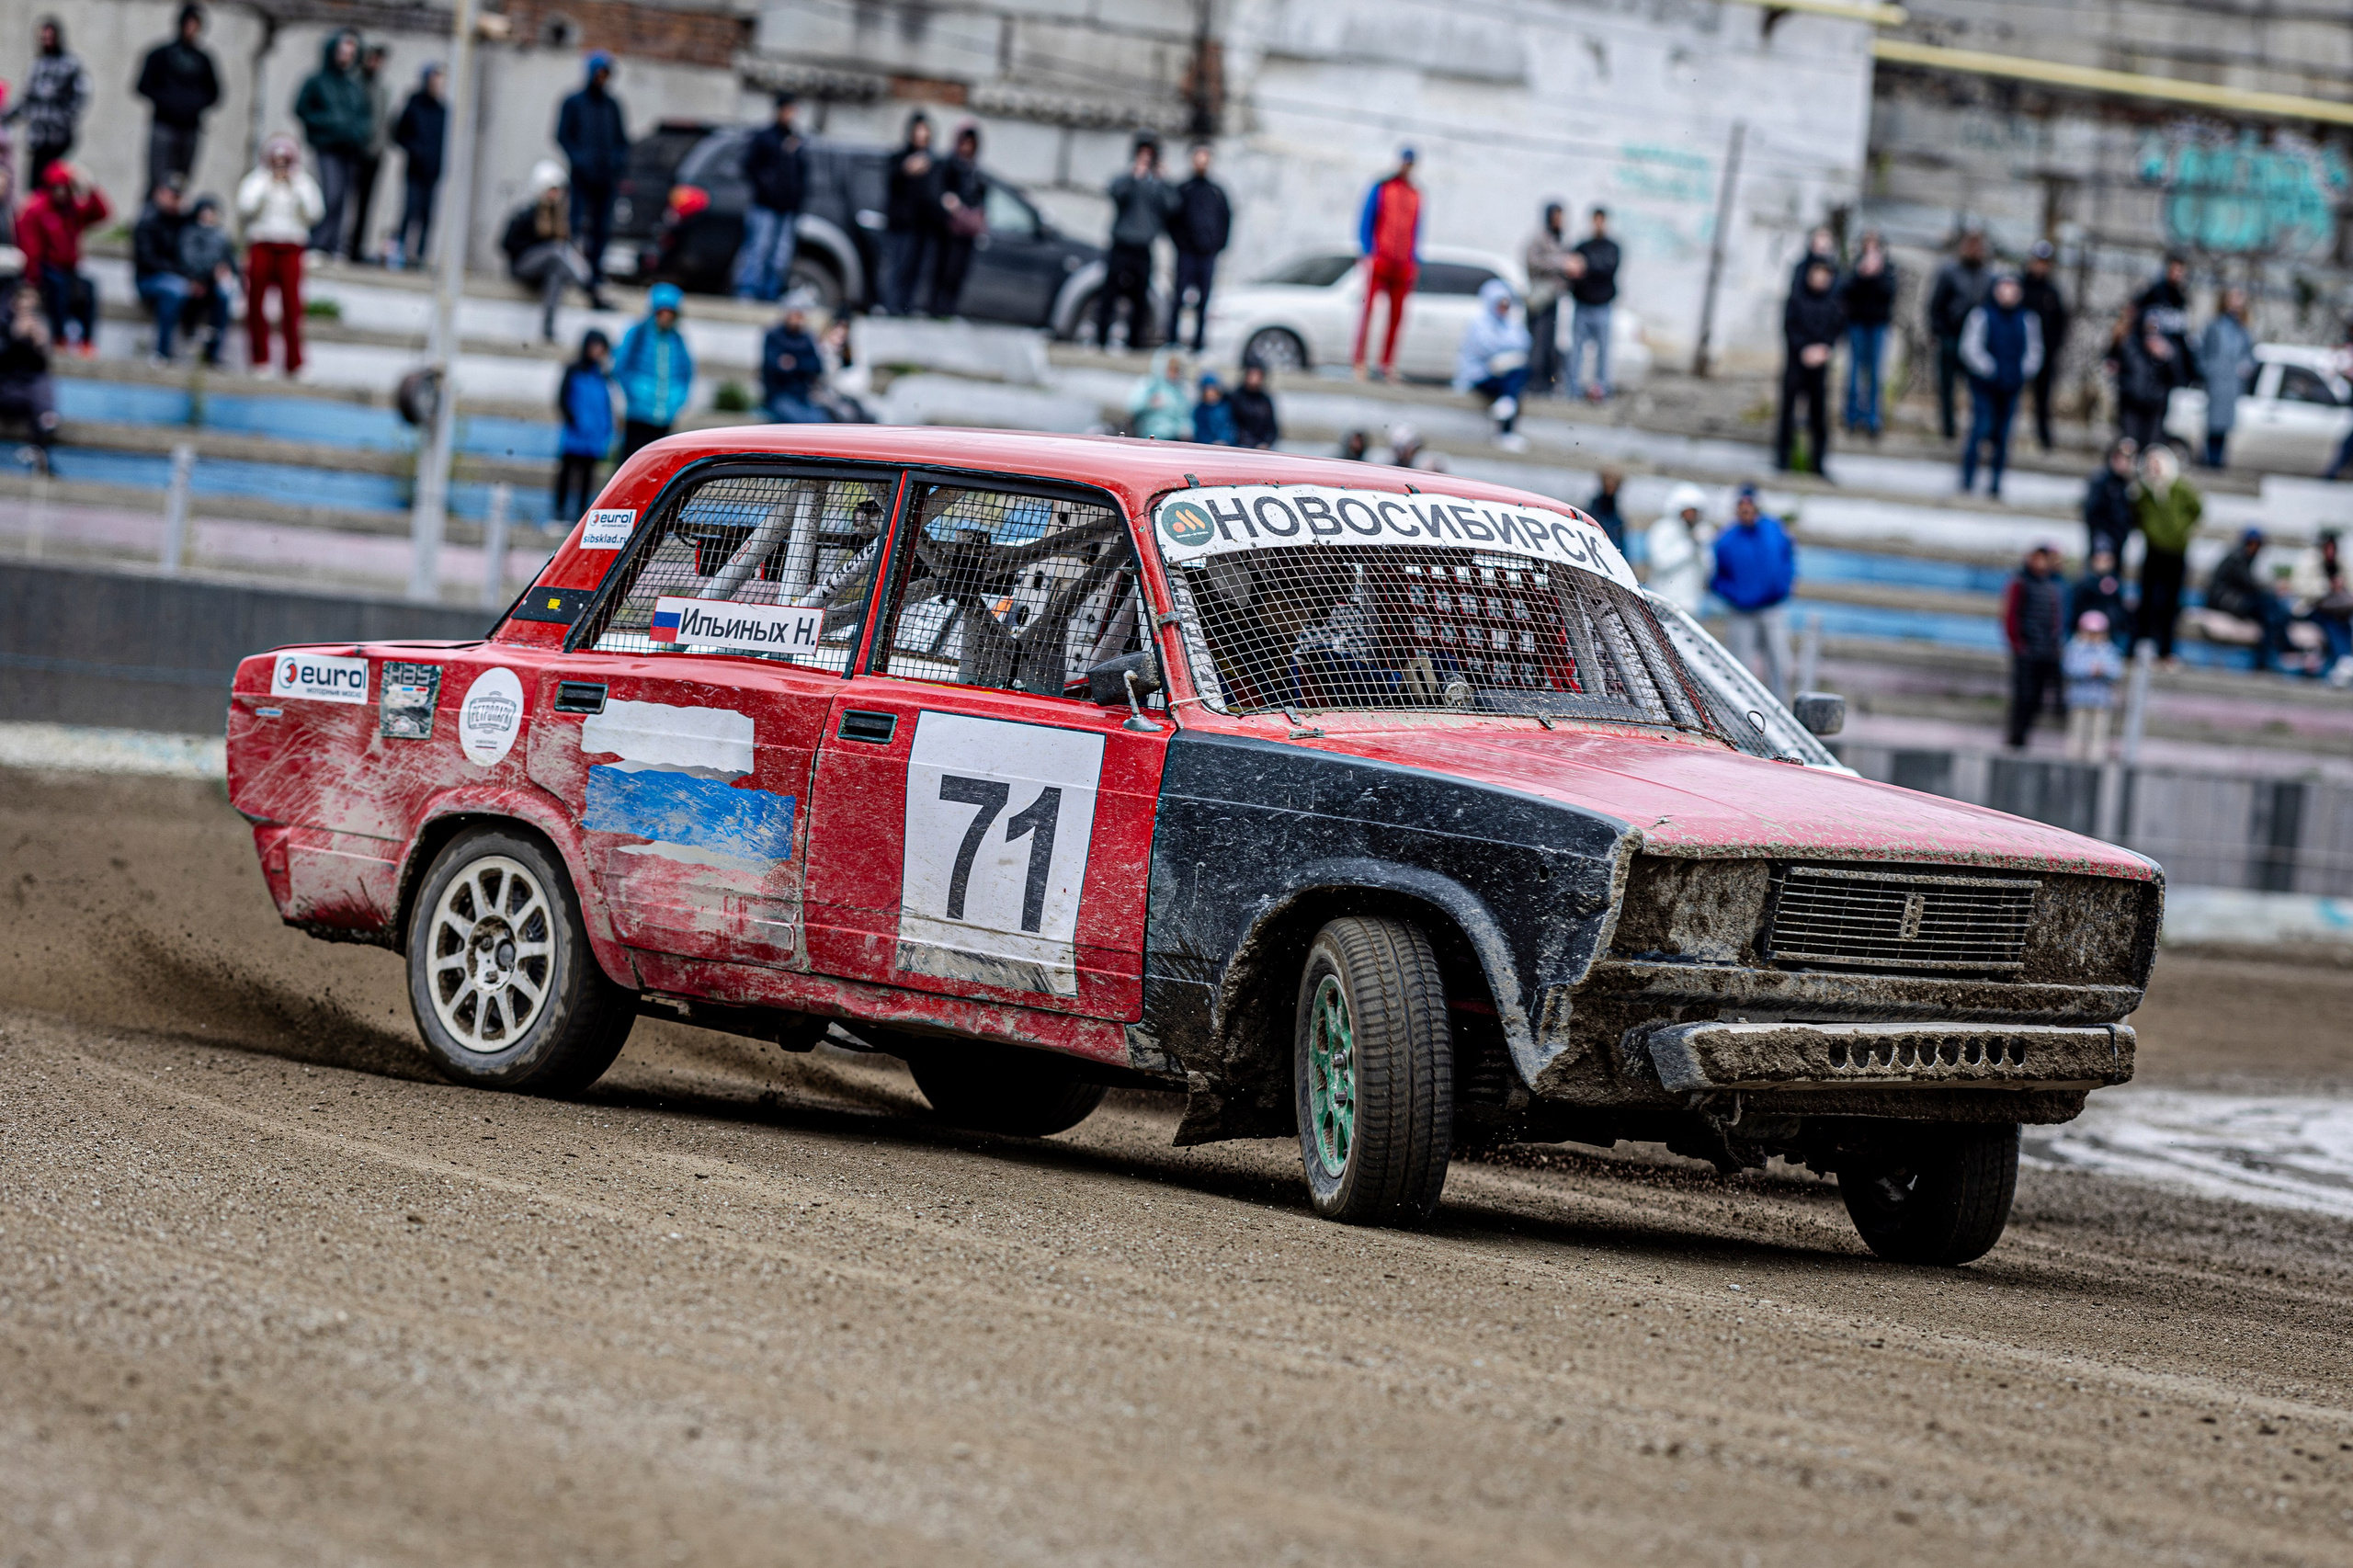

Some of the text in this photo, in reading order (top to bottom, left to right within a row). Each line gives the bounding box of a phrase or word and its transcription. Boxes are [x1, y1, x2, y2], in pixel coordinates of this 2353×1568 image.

[600, 511, 633, 524] eurol
[1205, 496, 1613, 575] НОВОСИБИРСК
[680, 608, 816, 646] Ильиных Н.
[301, 665, 367, 689] eurol
[939, 774, 1063, 934] 71
